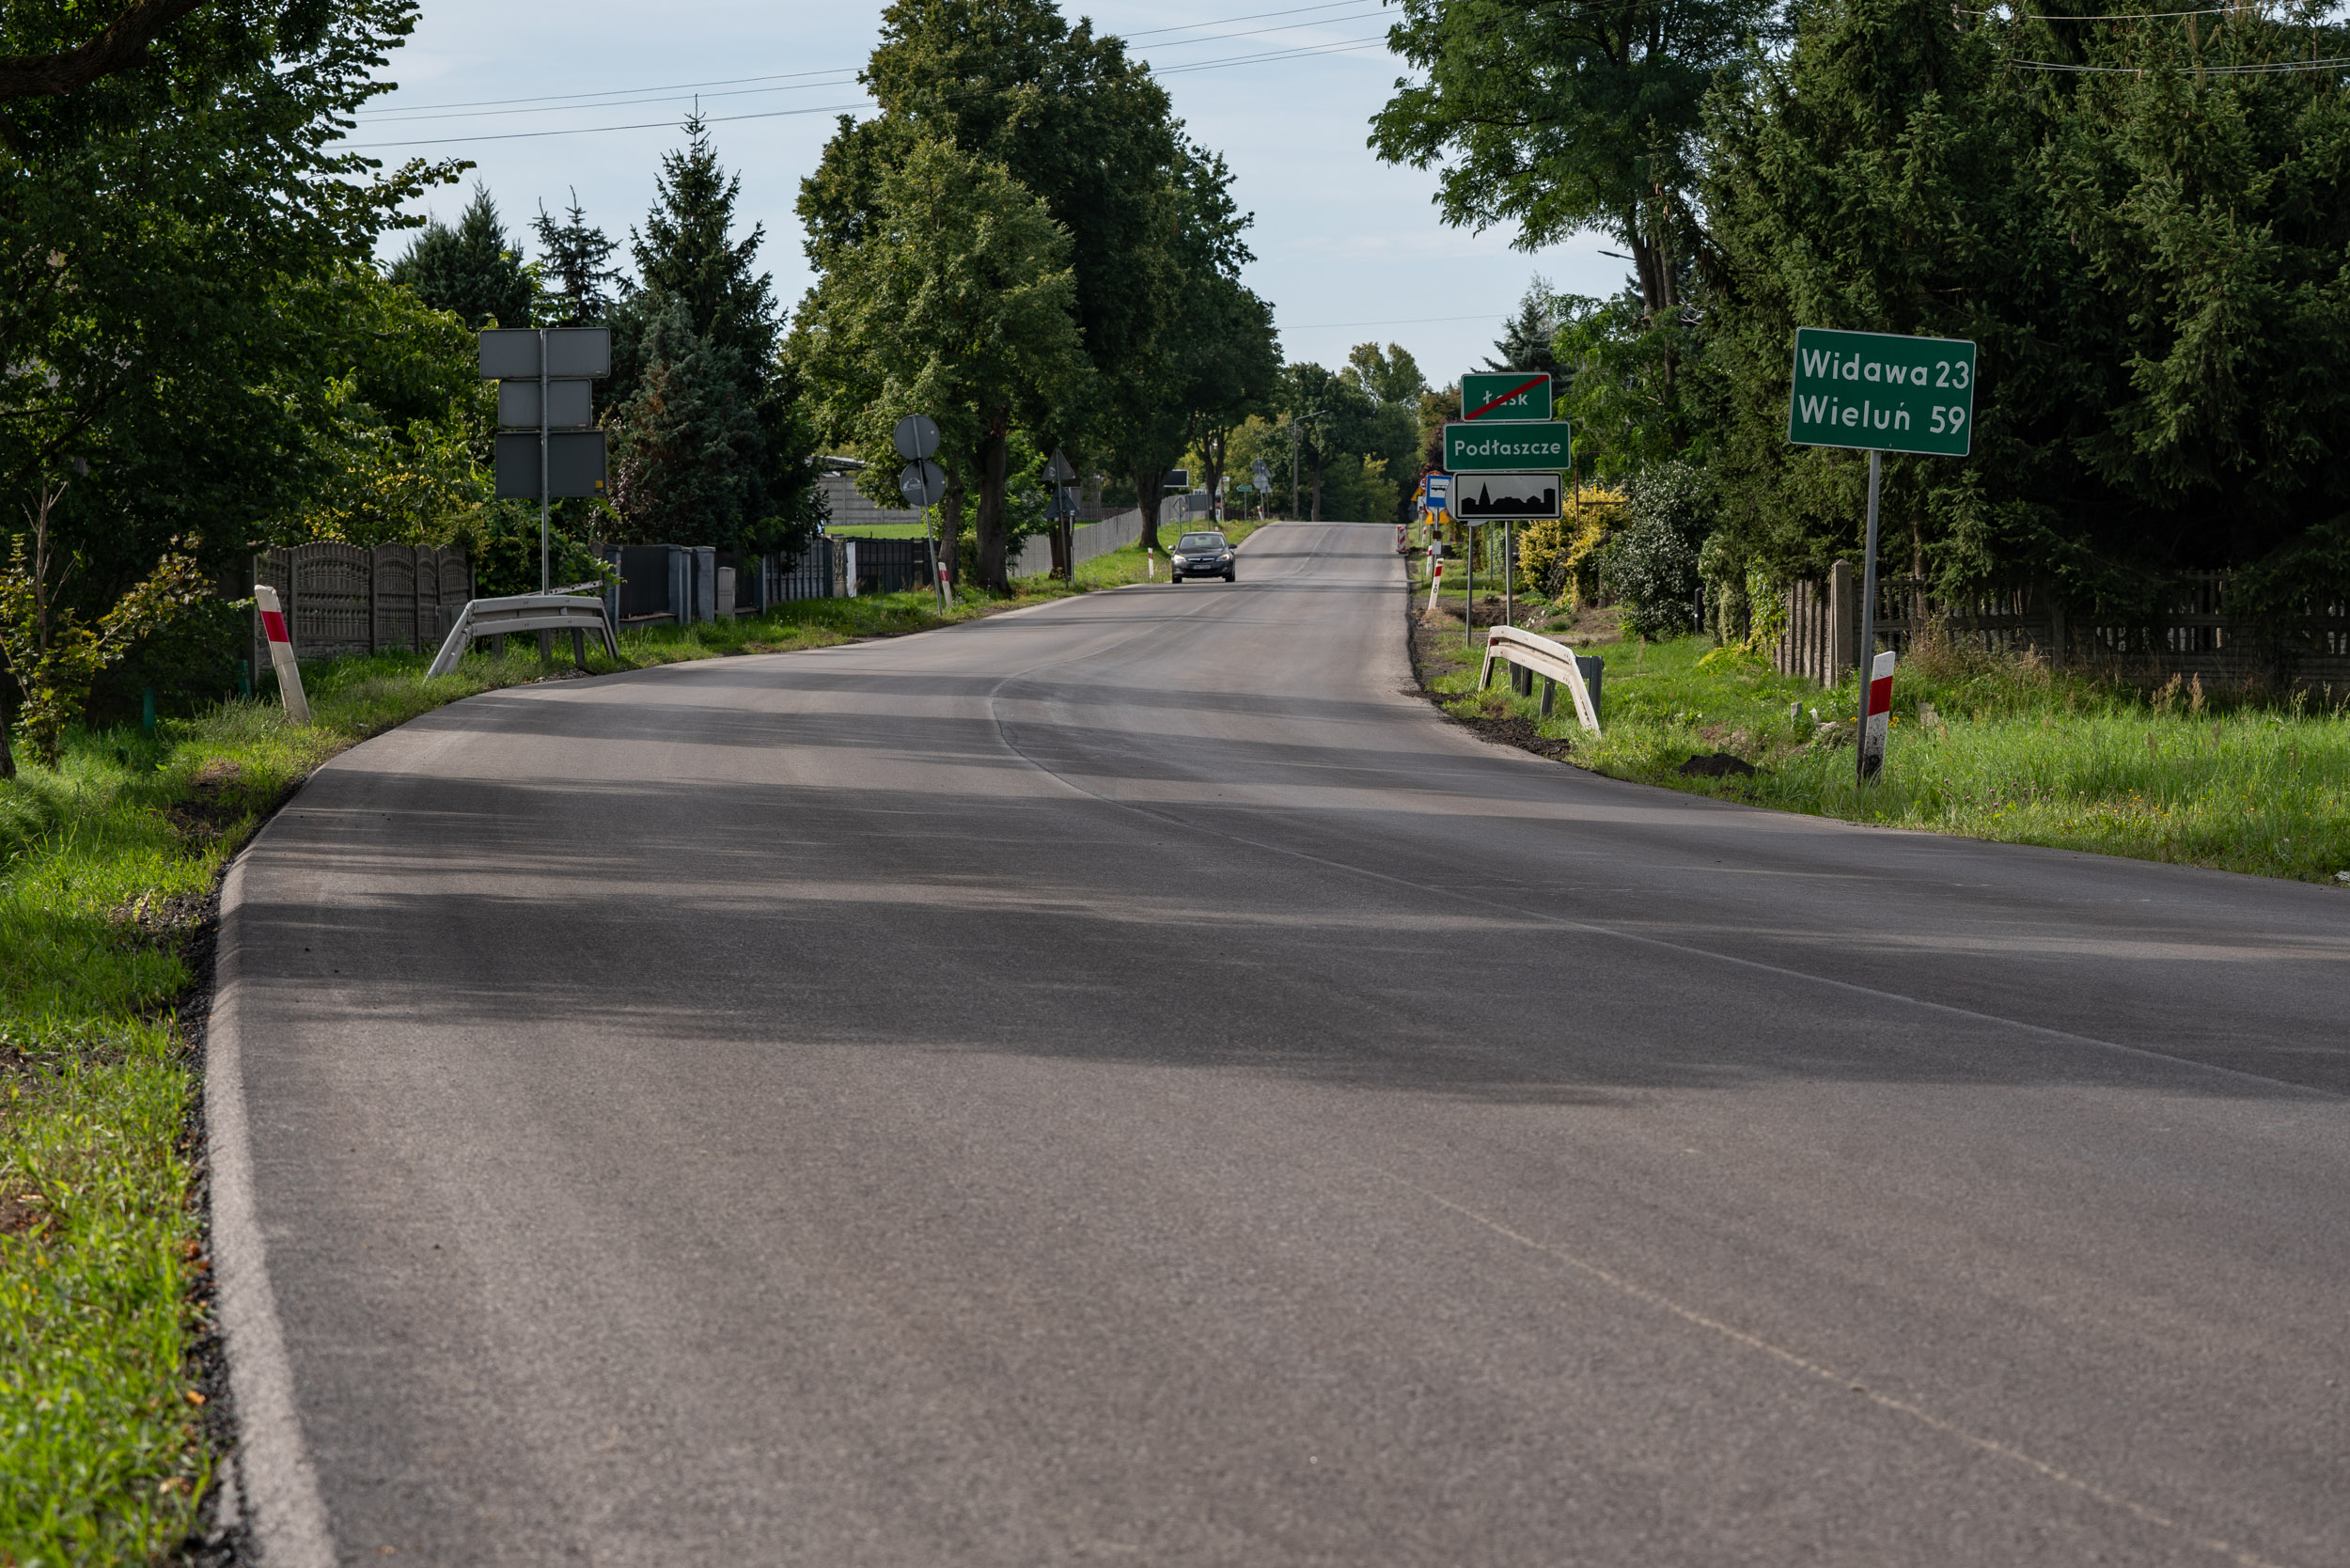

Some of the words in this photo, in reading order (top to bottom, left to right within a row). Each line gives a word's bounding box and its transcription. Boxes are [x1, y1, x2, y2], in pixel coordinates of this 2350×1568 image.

[1801, 348, 1928, 386] Widawa
[1935, 361, 1969, 389] 23
[1798, 394, 1910, 431] Wieluń
[1929, 405, 1966, 434] 59
[1454, 439, 1560, 456] Podłaszcze
